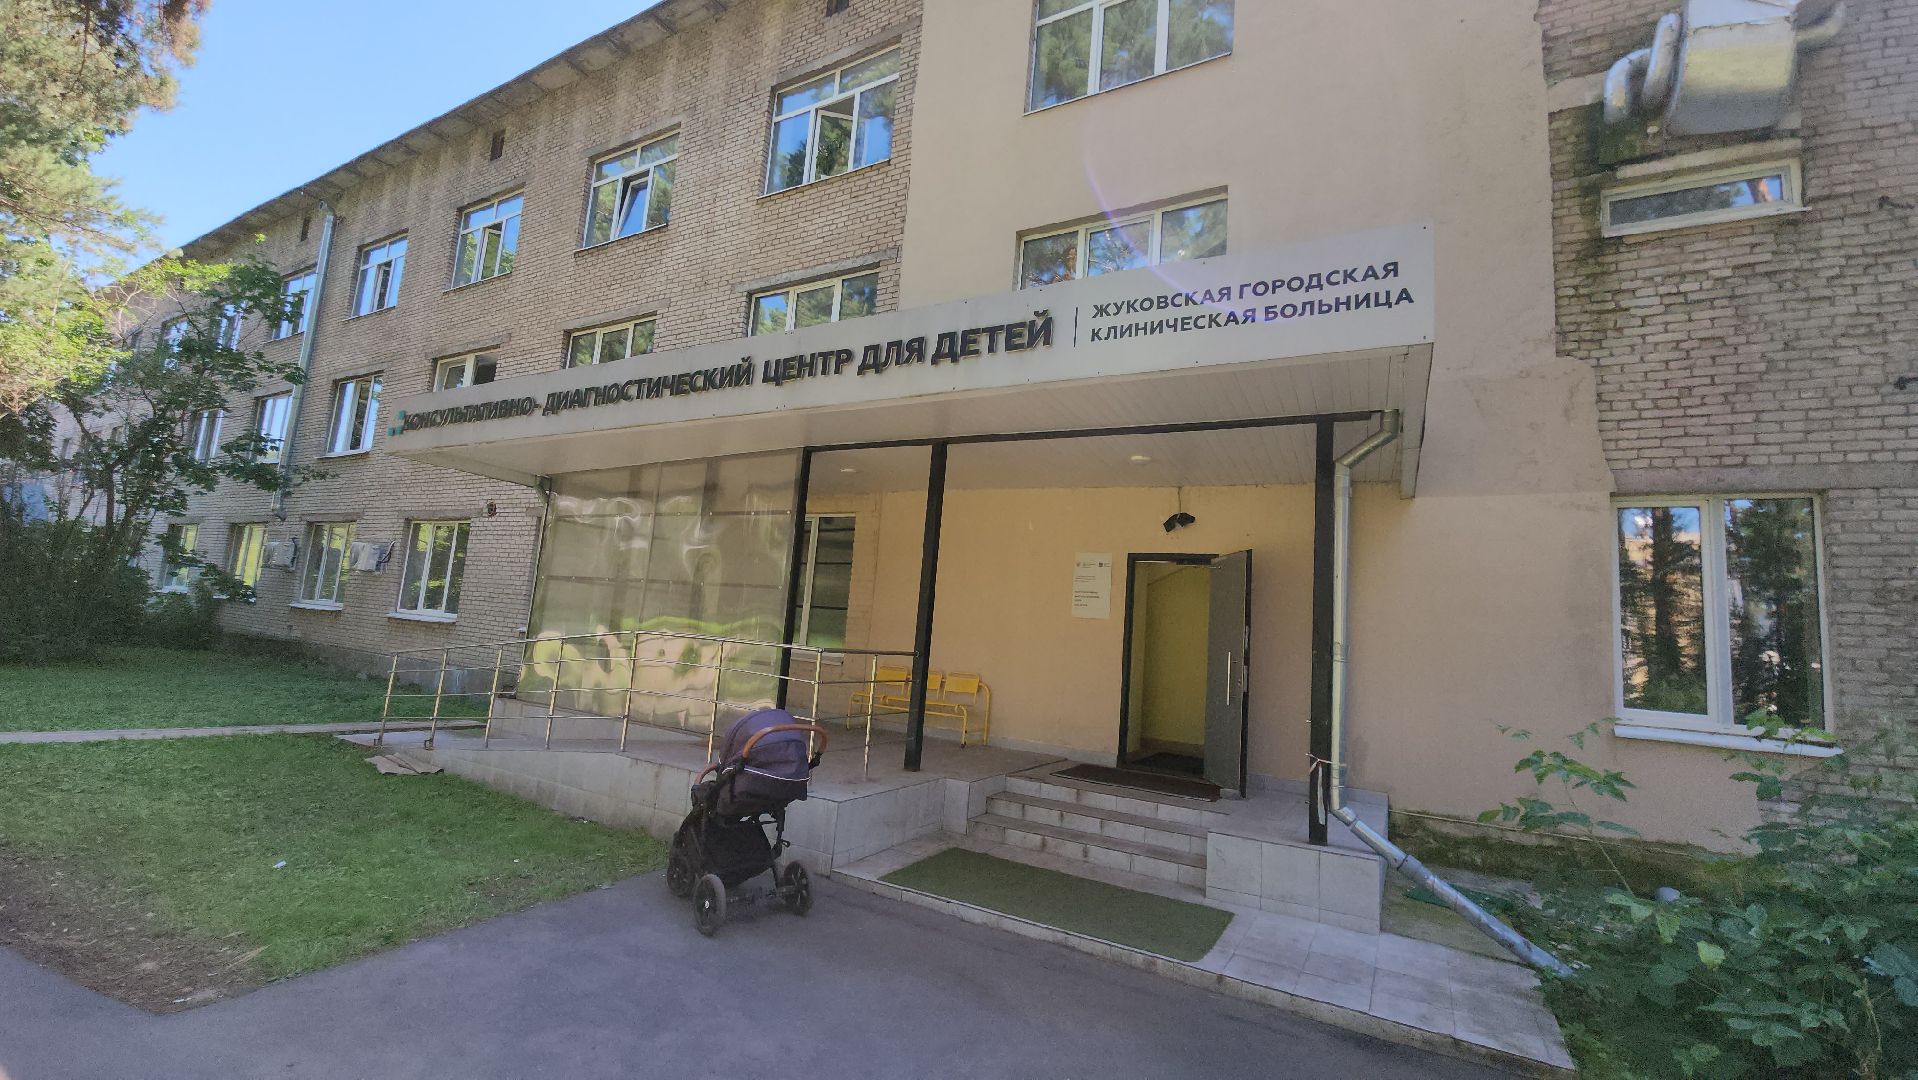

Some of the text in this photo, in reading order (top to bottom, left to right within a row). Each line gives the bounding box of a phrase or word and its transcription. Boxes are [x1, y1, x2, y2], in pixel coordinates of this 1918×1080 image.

[1090, 287, 1415, 342] КЛИНИЧЕСКАЯ БОЛЬНИЦА
[1092, 261, 1400, 319] ЖУКОВСКАЯ ГОРОДСКАЯ
[762, 348, 852, 386] ЦЕНТР
[857, 336, 926, 376] ДЛЯ
[931, 309, 1054, 366] ДЕТЕЙ
